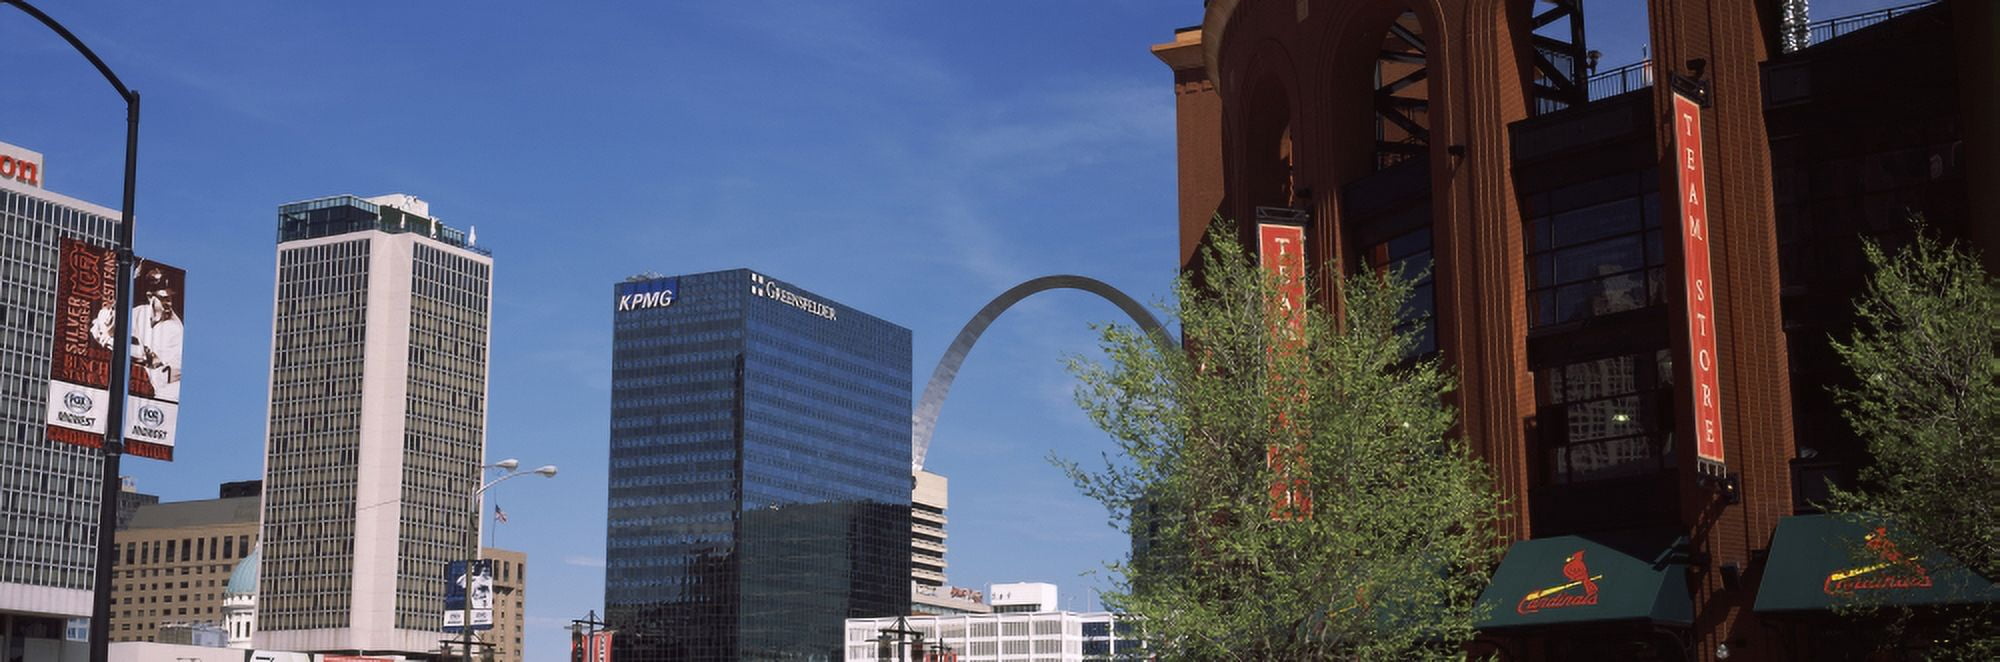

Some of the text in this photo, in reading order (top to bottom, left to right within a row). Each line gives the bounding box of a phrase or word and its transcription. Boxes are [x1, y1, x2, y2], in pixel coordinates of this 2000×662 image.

[618, 290, 673, 311] KPMG
[766, 281, 837, 320] GREENSFELDER
[1683, 113, 1715, 443] TEAM STORE
[66, 296, 81, 353] SILVER
[77, 299, 91, 356] SLUGGER
[1516, 590, 1598, 616] Cardinals
